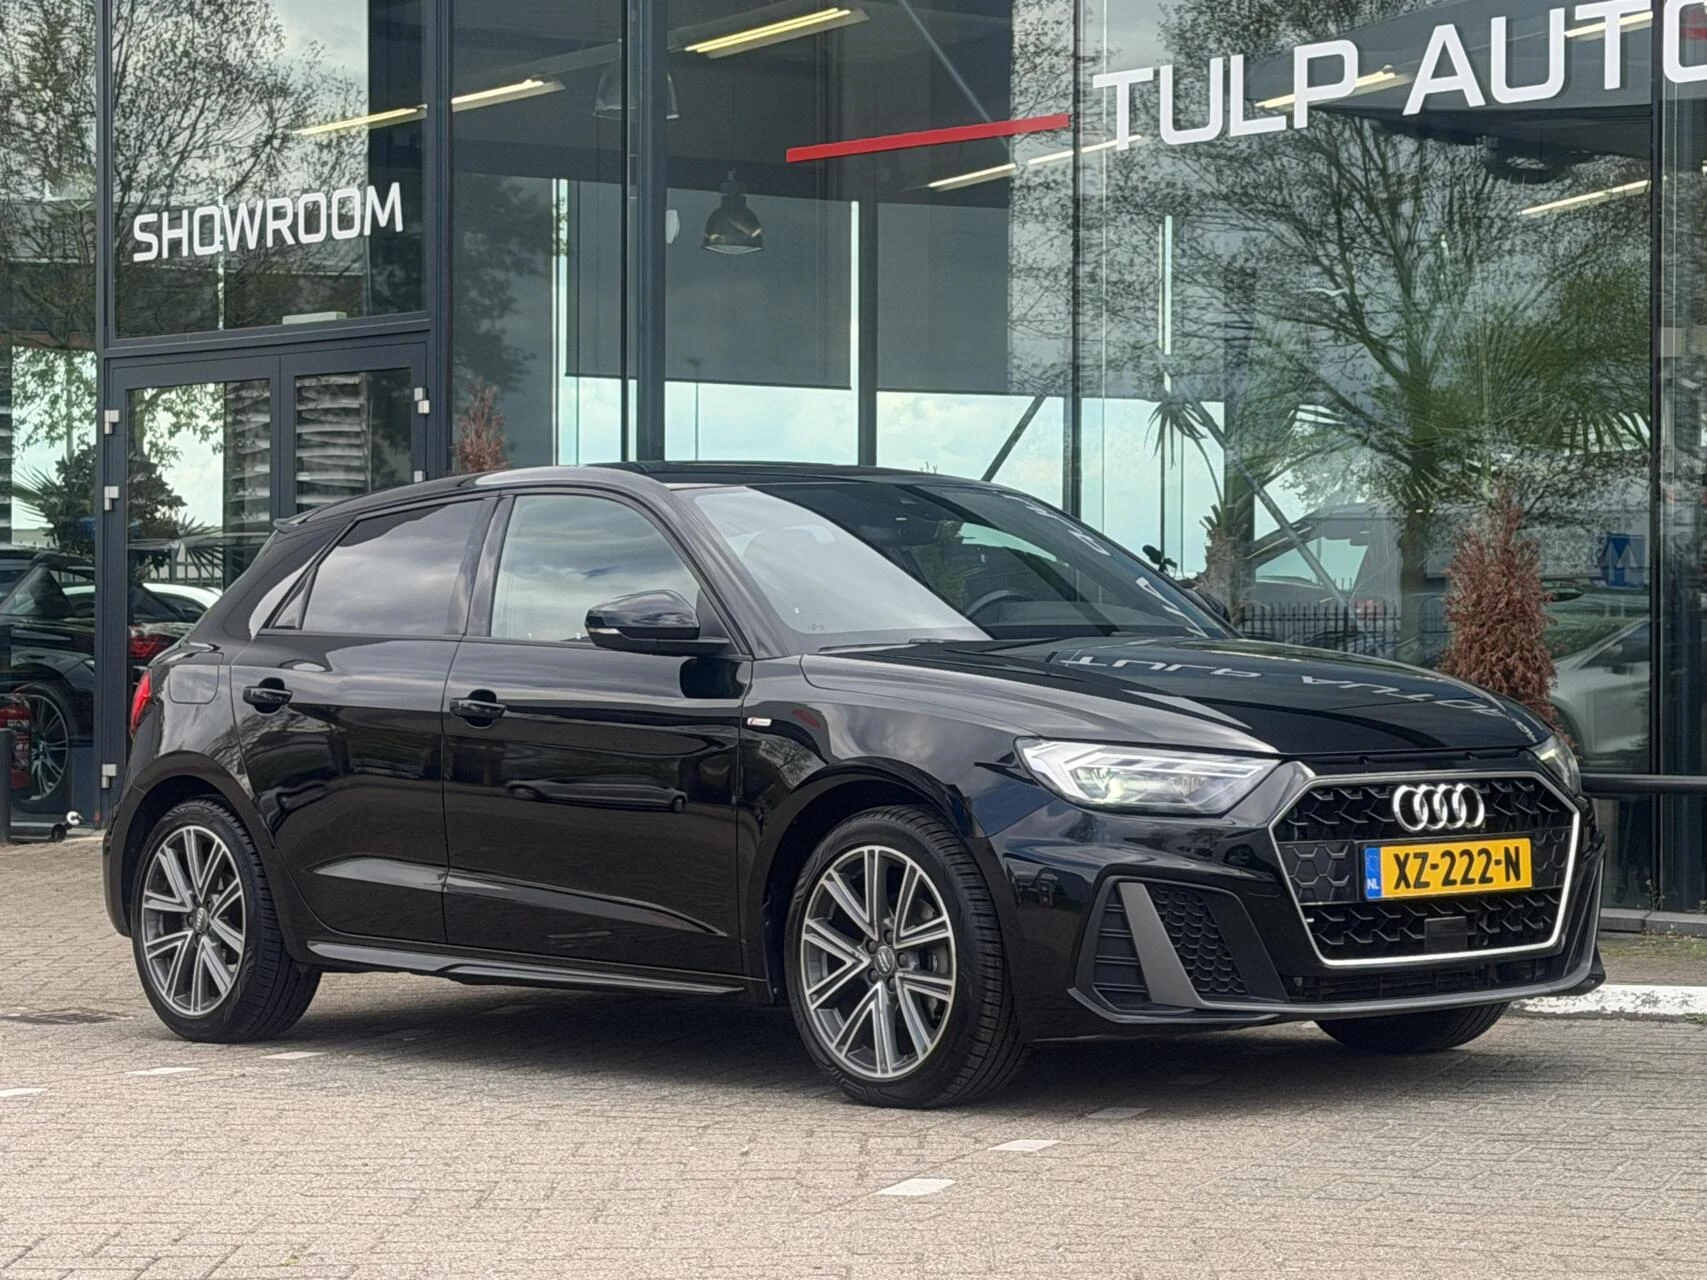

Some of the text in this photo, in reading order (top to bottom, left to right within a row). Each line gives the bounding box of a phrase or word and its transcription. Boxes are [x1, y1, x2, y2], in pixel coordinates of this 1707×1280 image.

[1092, 39, 1359, 151] TULP
[133, 181, 404, 262] SHOWROOM
[1366, 877, 1380, 890] NL
[1393, 846, 1522, 890] XZ-222-N
